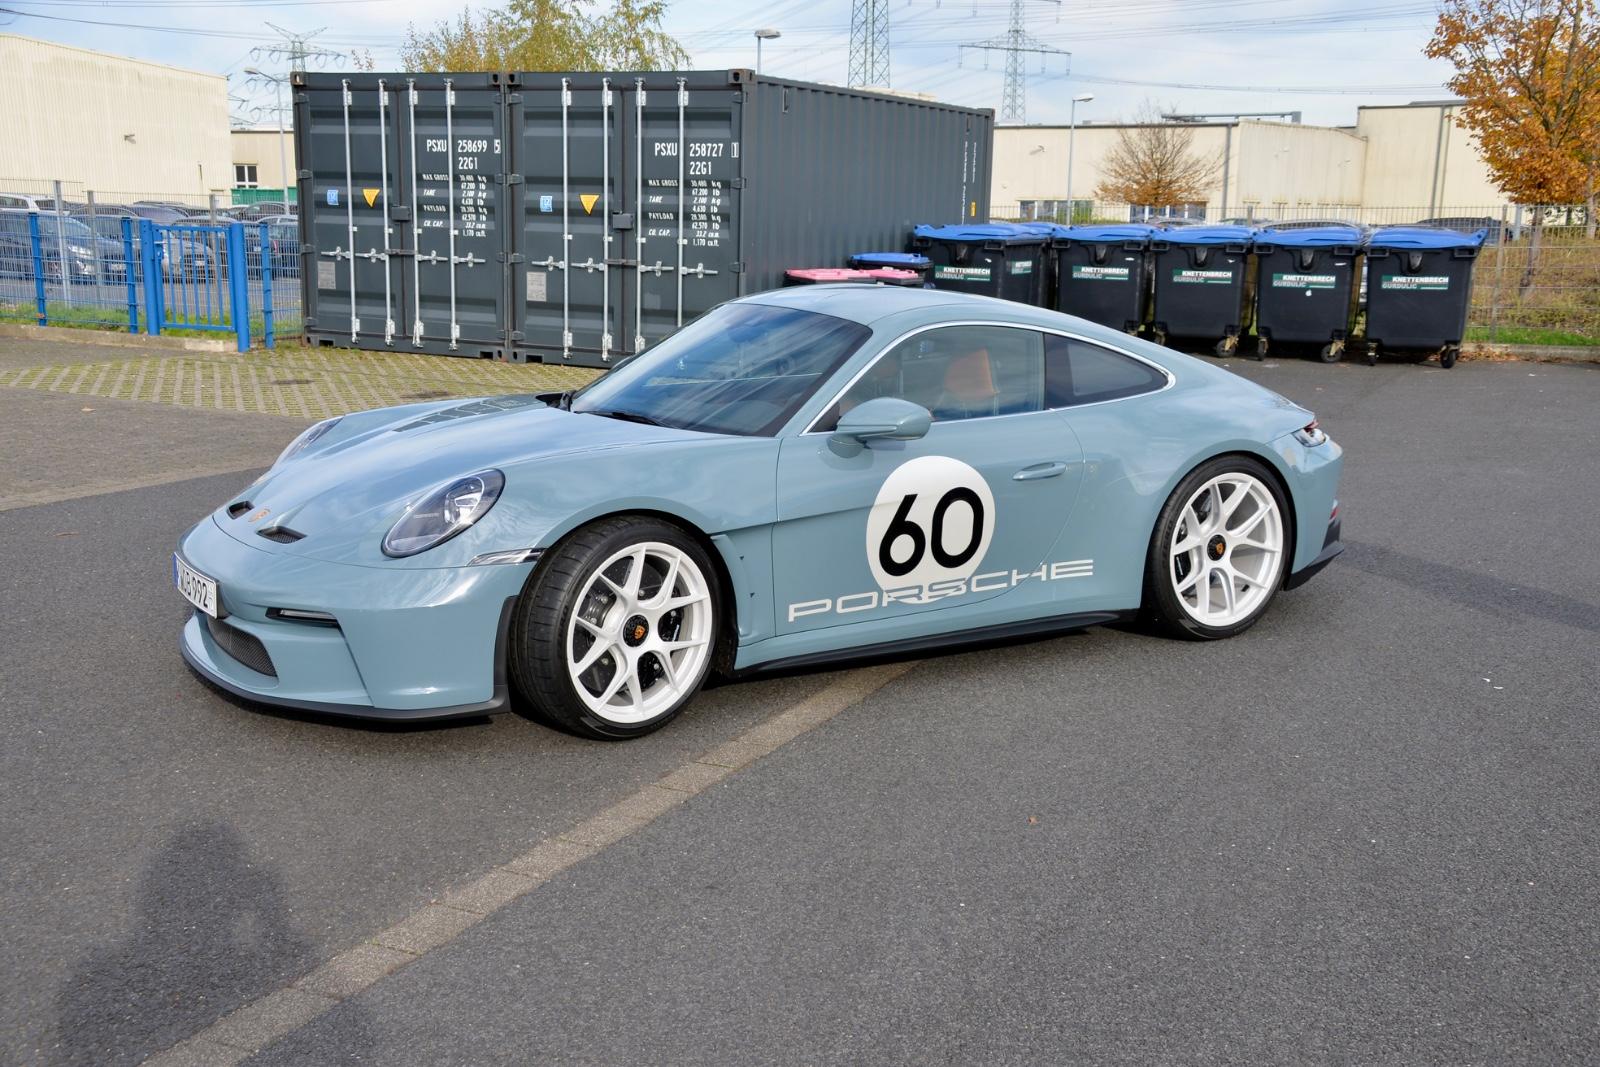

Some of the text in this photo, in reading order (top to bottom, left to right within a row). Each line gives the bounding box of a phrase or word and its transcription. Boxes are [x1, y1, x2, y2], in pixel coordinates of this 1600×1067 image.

[426, 139, 447, 153] PSXU
[458, 140, 488, 153] 258699
[655, 142, 678, 157] PSXU
[689, 143, 724, 157] 258727
[458, 157, 478, 170] 22G1
[690, 161, 712, 175] 22G1
[712, 188, 720, 196] lb
[712, 222, 720, 230] lb
[1182, 270, 1232, 278] KNETTENBRECH
[1282, 275, 1336, 283] KNETTENBRECH
[879, 486, 984, 576] 60
[788, 559, 1094, 623] PORSCHE
